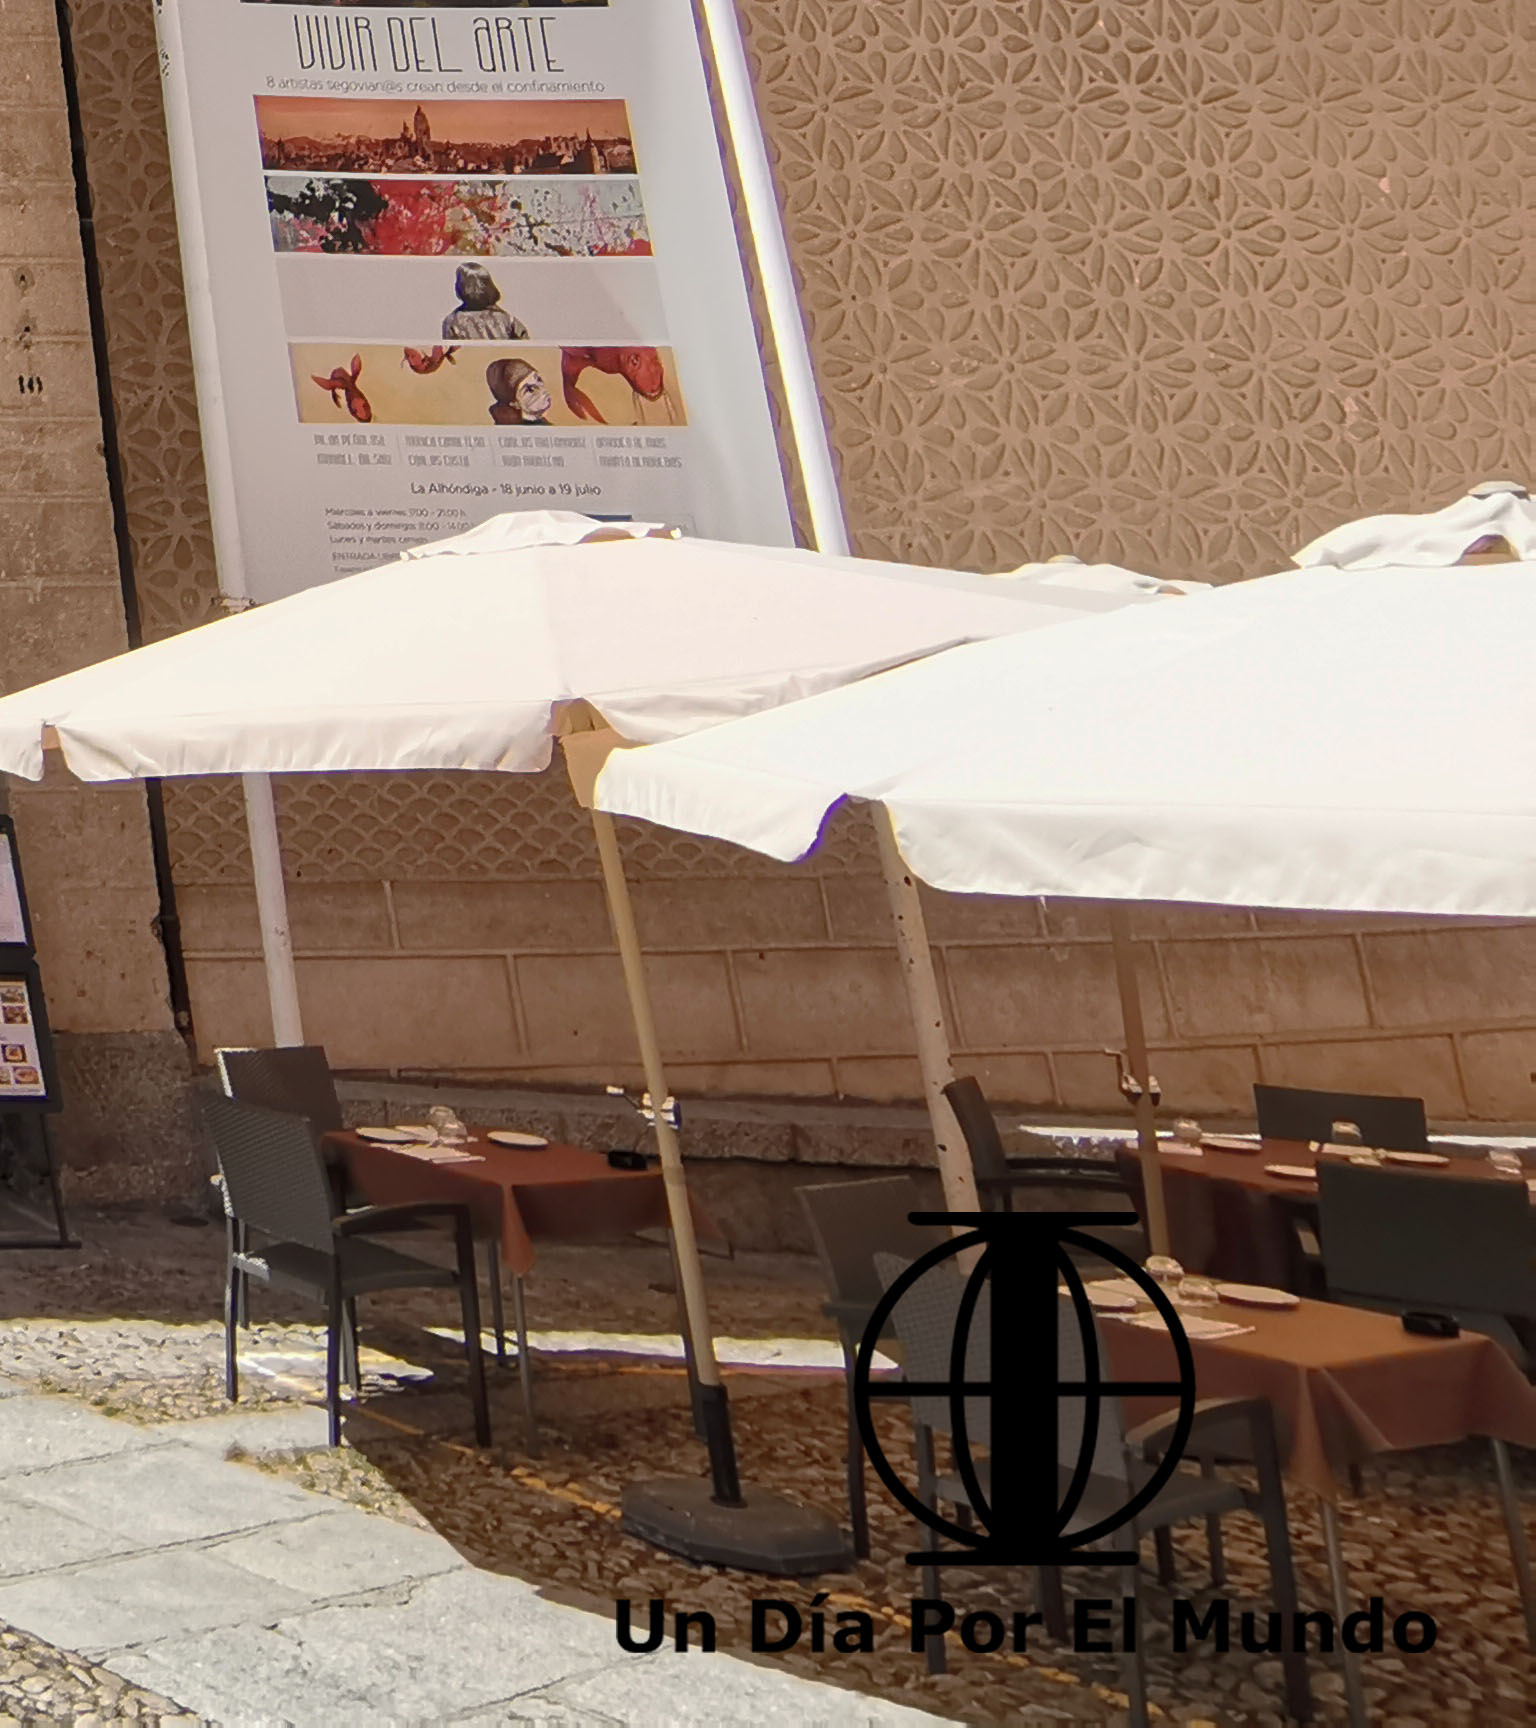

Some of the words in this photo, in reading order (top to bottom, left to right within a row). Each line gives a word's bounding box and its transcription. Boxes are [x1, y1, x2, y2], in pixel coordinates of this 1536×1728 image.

[386, 15, 464, 73] DEL
[265, 75, 276, 89] 8
[278, 76, 324, 91] artistas
[406, 80, 444, 92] crean
[446, 79, 489, 93] desde
[491, 80, 503, 93] el
[506, 78, 606, 93] confinamiento
[410, 481, 426, 495] La
[428, 481, 489, 497] Alhóndiga
[499, 482, 513, 495] 18
[515, 483, 546, 497] junio
[548, 485, 556, 495] a
[558, 482, 572, 495] 19
[574, 482, 602, 497] julio
